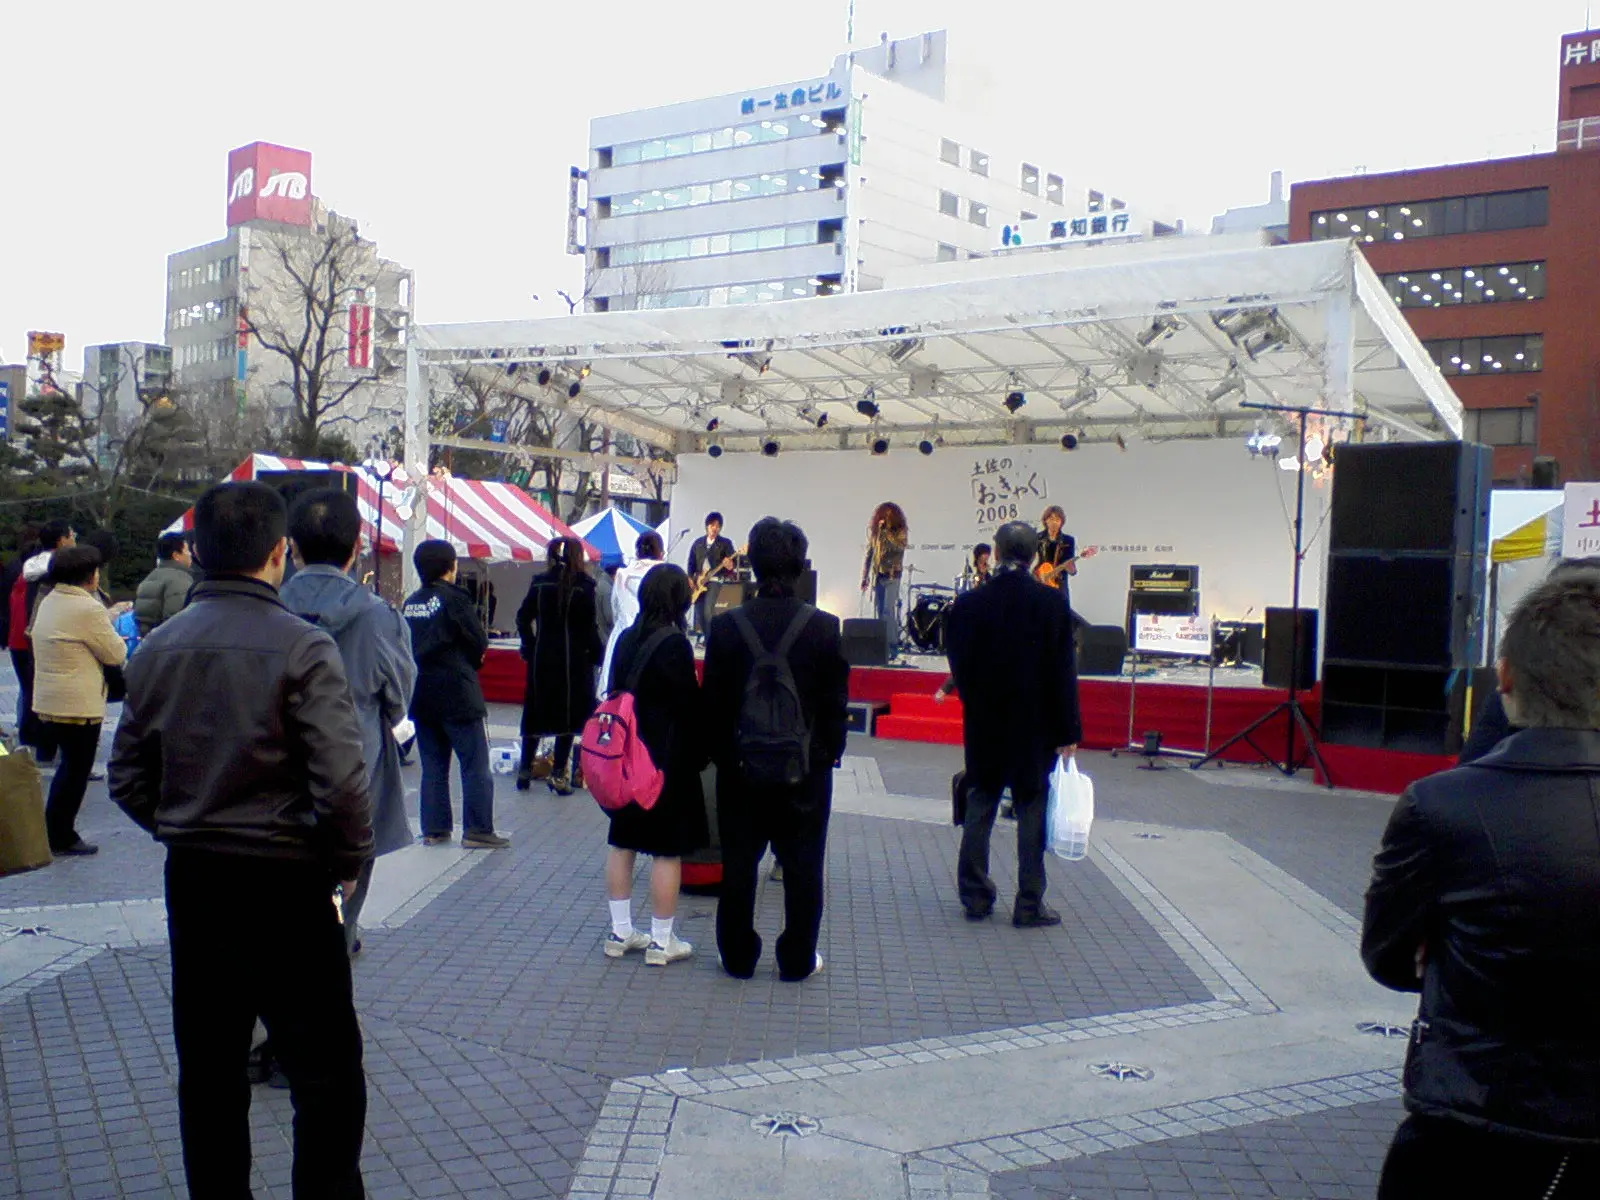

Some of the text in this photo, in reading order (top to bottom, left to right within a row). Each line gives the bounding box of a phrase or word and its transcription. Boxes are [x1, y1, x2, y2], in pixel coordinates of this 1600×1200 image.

[259, 168, 307, 199] JTB
[1050, 214, 1129, 239] 高知銀行
[971, 457, 1013, 476] 土佐の
[976, 503, 1018, 524] 2008
